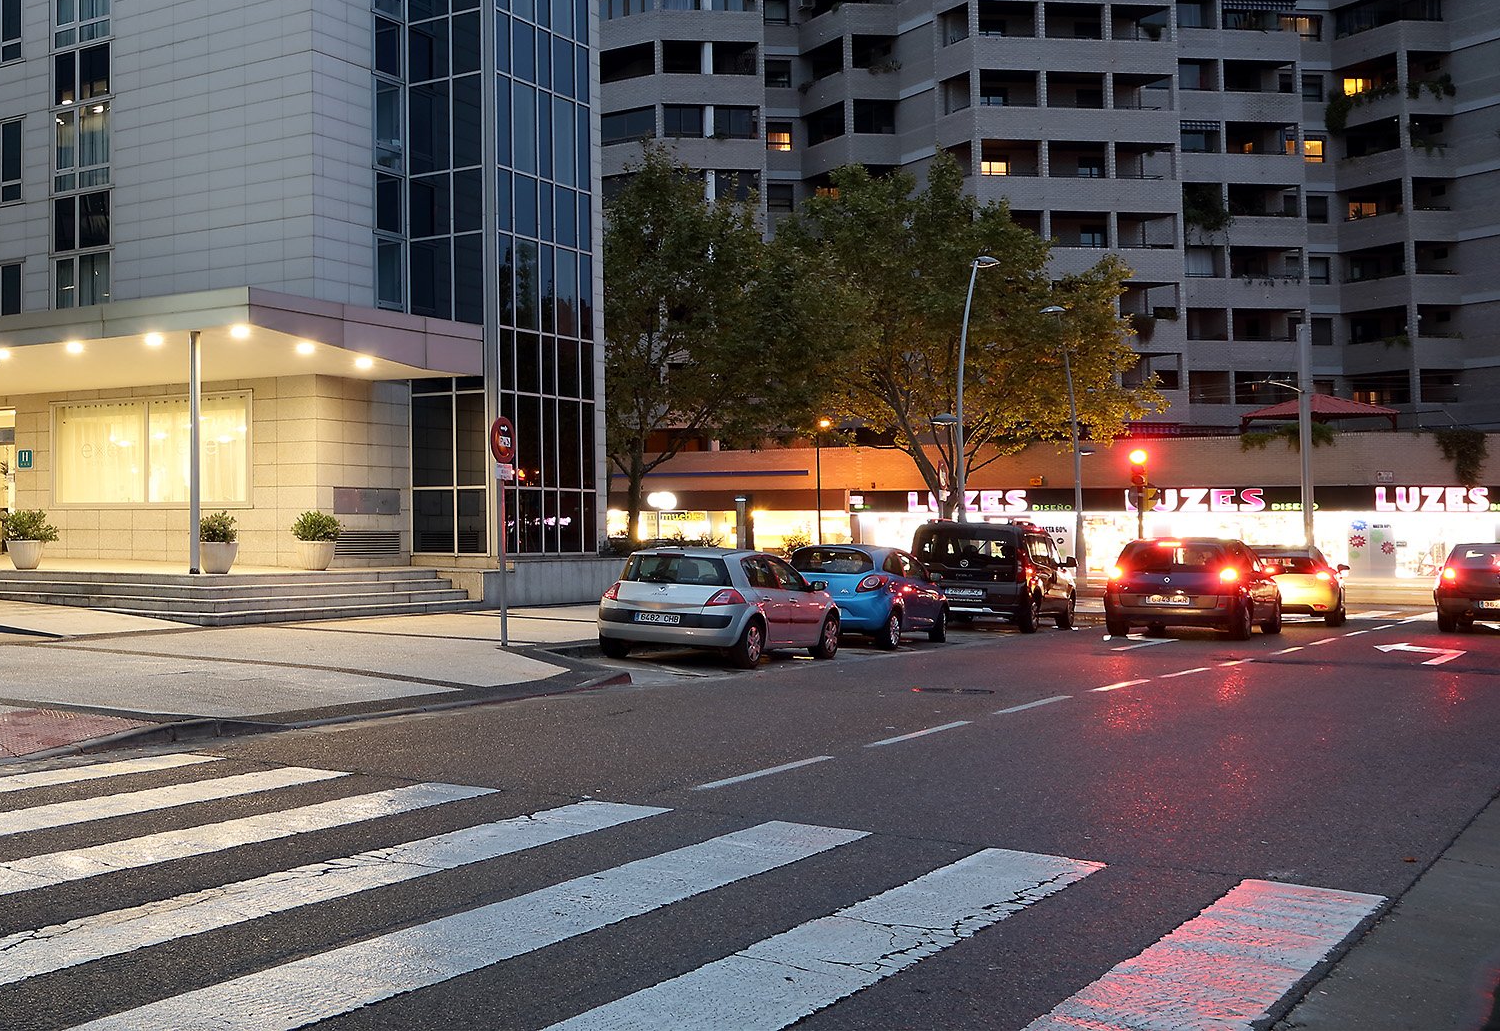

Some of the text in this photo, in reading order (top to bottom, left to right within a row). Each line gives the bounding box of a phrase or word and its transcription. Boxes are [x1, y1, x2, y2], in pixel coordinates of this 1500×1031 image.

[1374, 487, 1490, 512] LUZES
[1031, 503, 1072, 511] DISEÑO
[1271, 503, 1319, 511] DISEO
[660, 511, 705, 521] muebles
[640, 613, 679, 623] 6482 CHB
